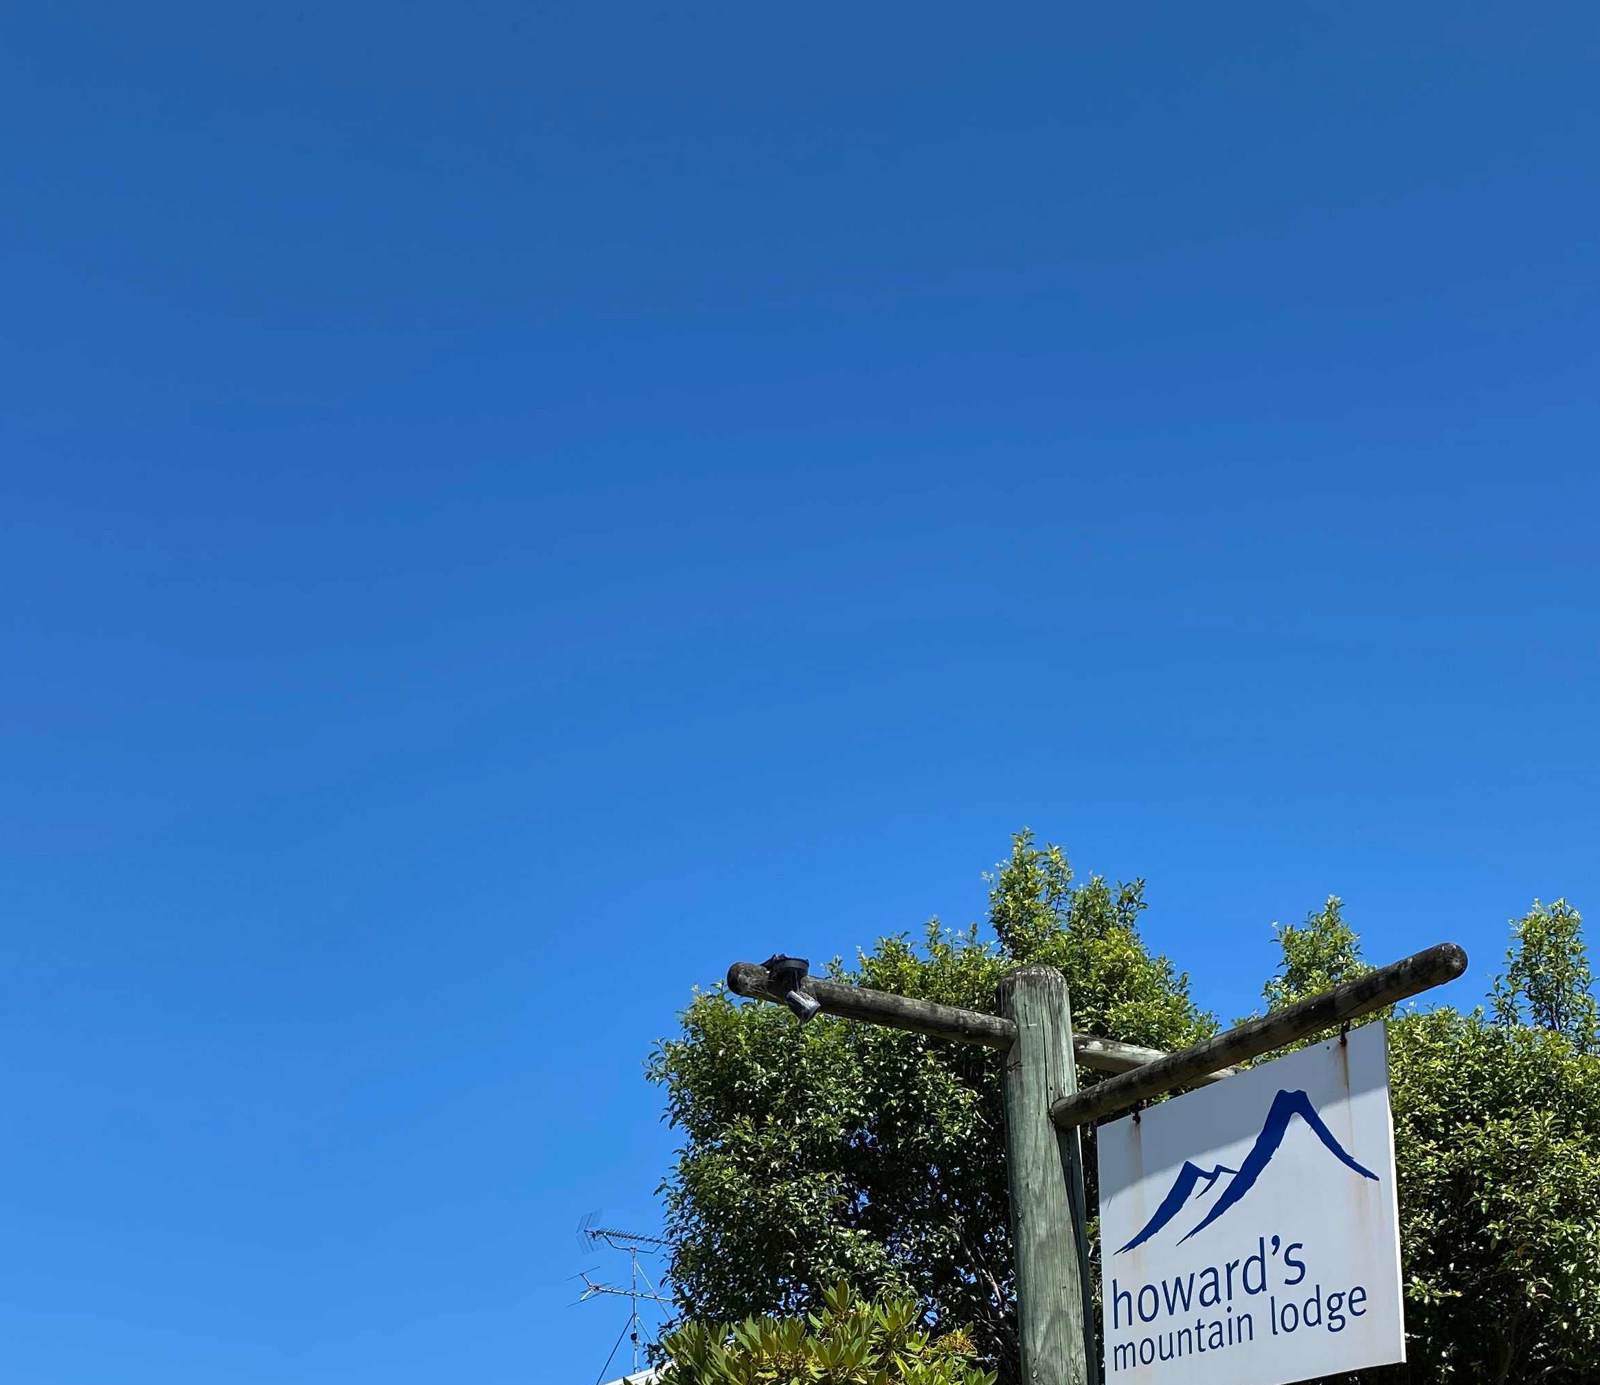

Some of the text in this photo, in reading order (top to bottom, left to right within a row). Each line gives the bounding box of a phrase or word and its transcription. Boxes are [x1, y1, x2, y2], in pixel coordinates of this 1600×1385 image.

[1112, 1234, 1306, 1330] howard's
[1113, 1284, 1367, 1372] mountain lodge
